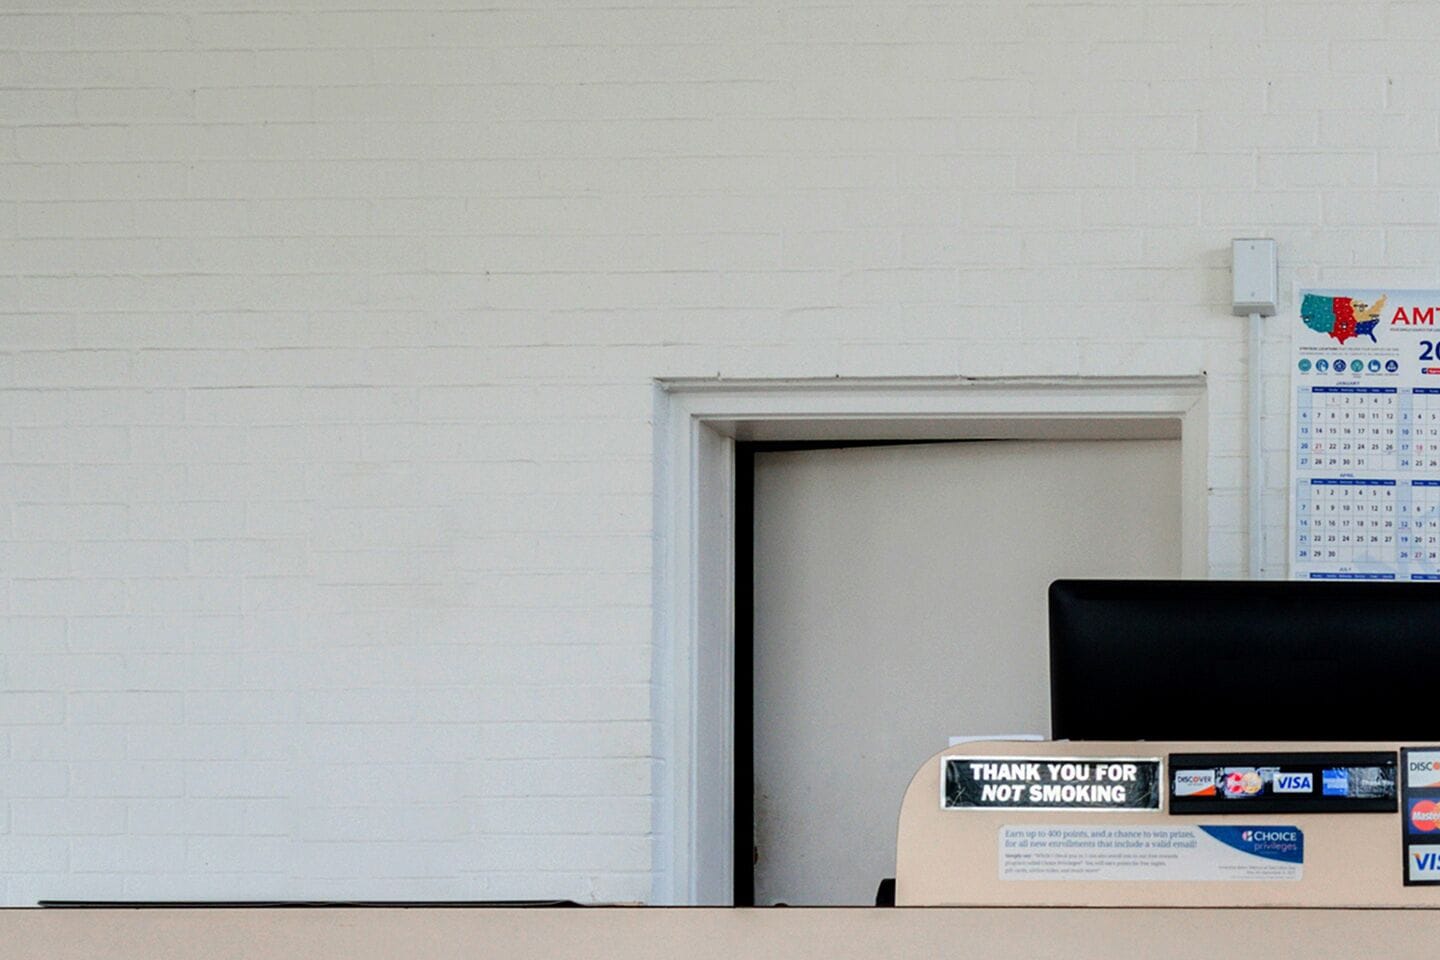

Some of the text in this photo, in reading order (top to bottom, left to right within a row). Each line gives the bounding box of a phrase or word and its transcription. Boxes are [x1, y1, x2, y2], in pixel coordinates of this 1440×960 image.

[970, 763, 1138, 781] THANK YOU FOR
[1278, 776, 1311, 789] VISA
[981, 784, 1126, 803] NOT SMOKING
[1063, 831, 1089, 839] points,
[1254, 831, 1296, 841] CHOICE
[1254, 843, 1296, 852] privileges
